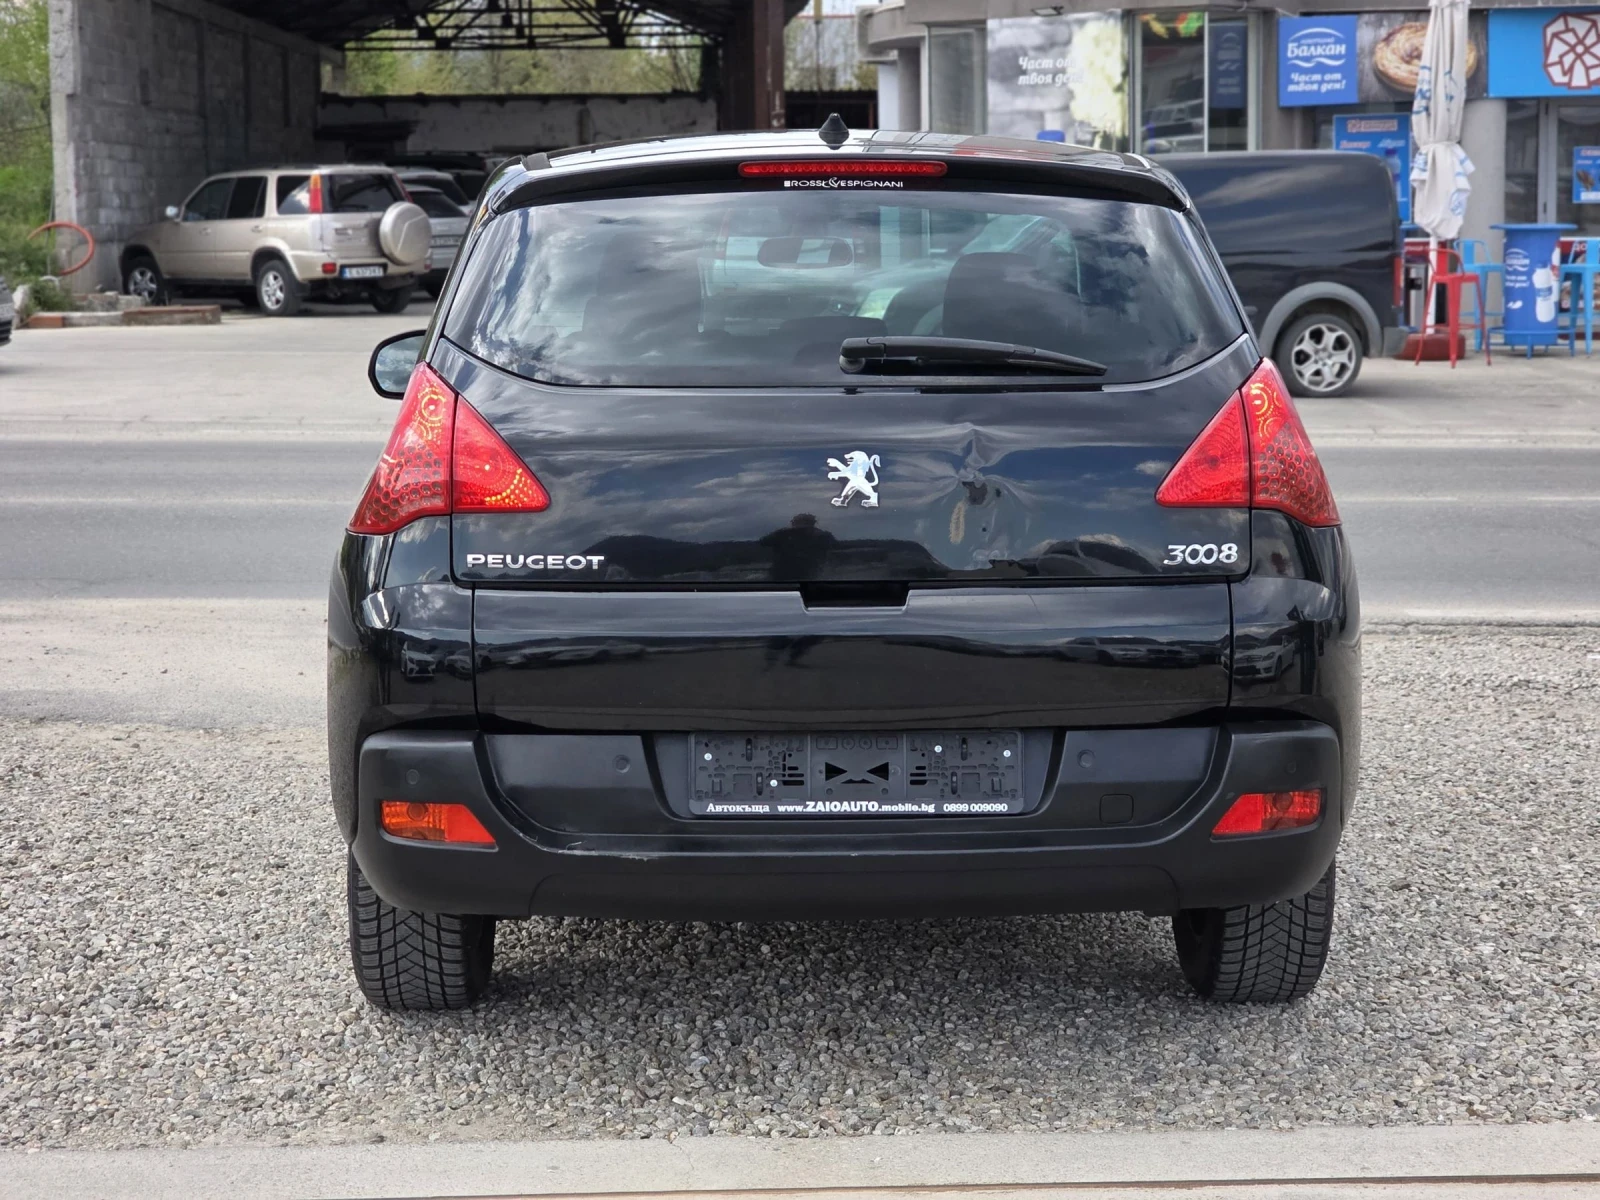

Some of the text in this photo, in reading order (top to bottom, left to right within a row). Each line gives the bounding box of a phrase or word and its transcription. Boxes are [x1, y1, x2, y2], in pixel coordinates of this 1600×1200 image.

[1287, 42, 1346, 58] Балкан
[1018, 56, 1054, 70] Част
[1017, 72, 1053, 86] твоя
[466, 554, 605, 570] PEUGEOT
[1163, 543, 1238, 566] 3008
[706, 803, 770, 814] Автокъща
[943, 803, 969, 812] 0899
[970, 803, 1008, 812] 009090
